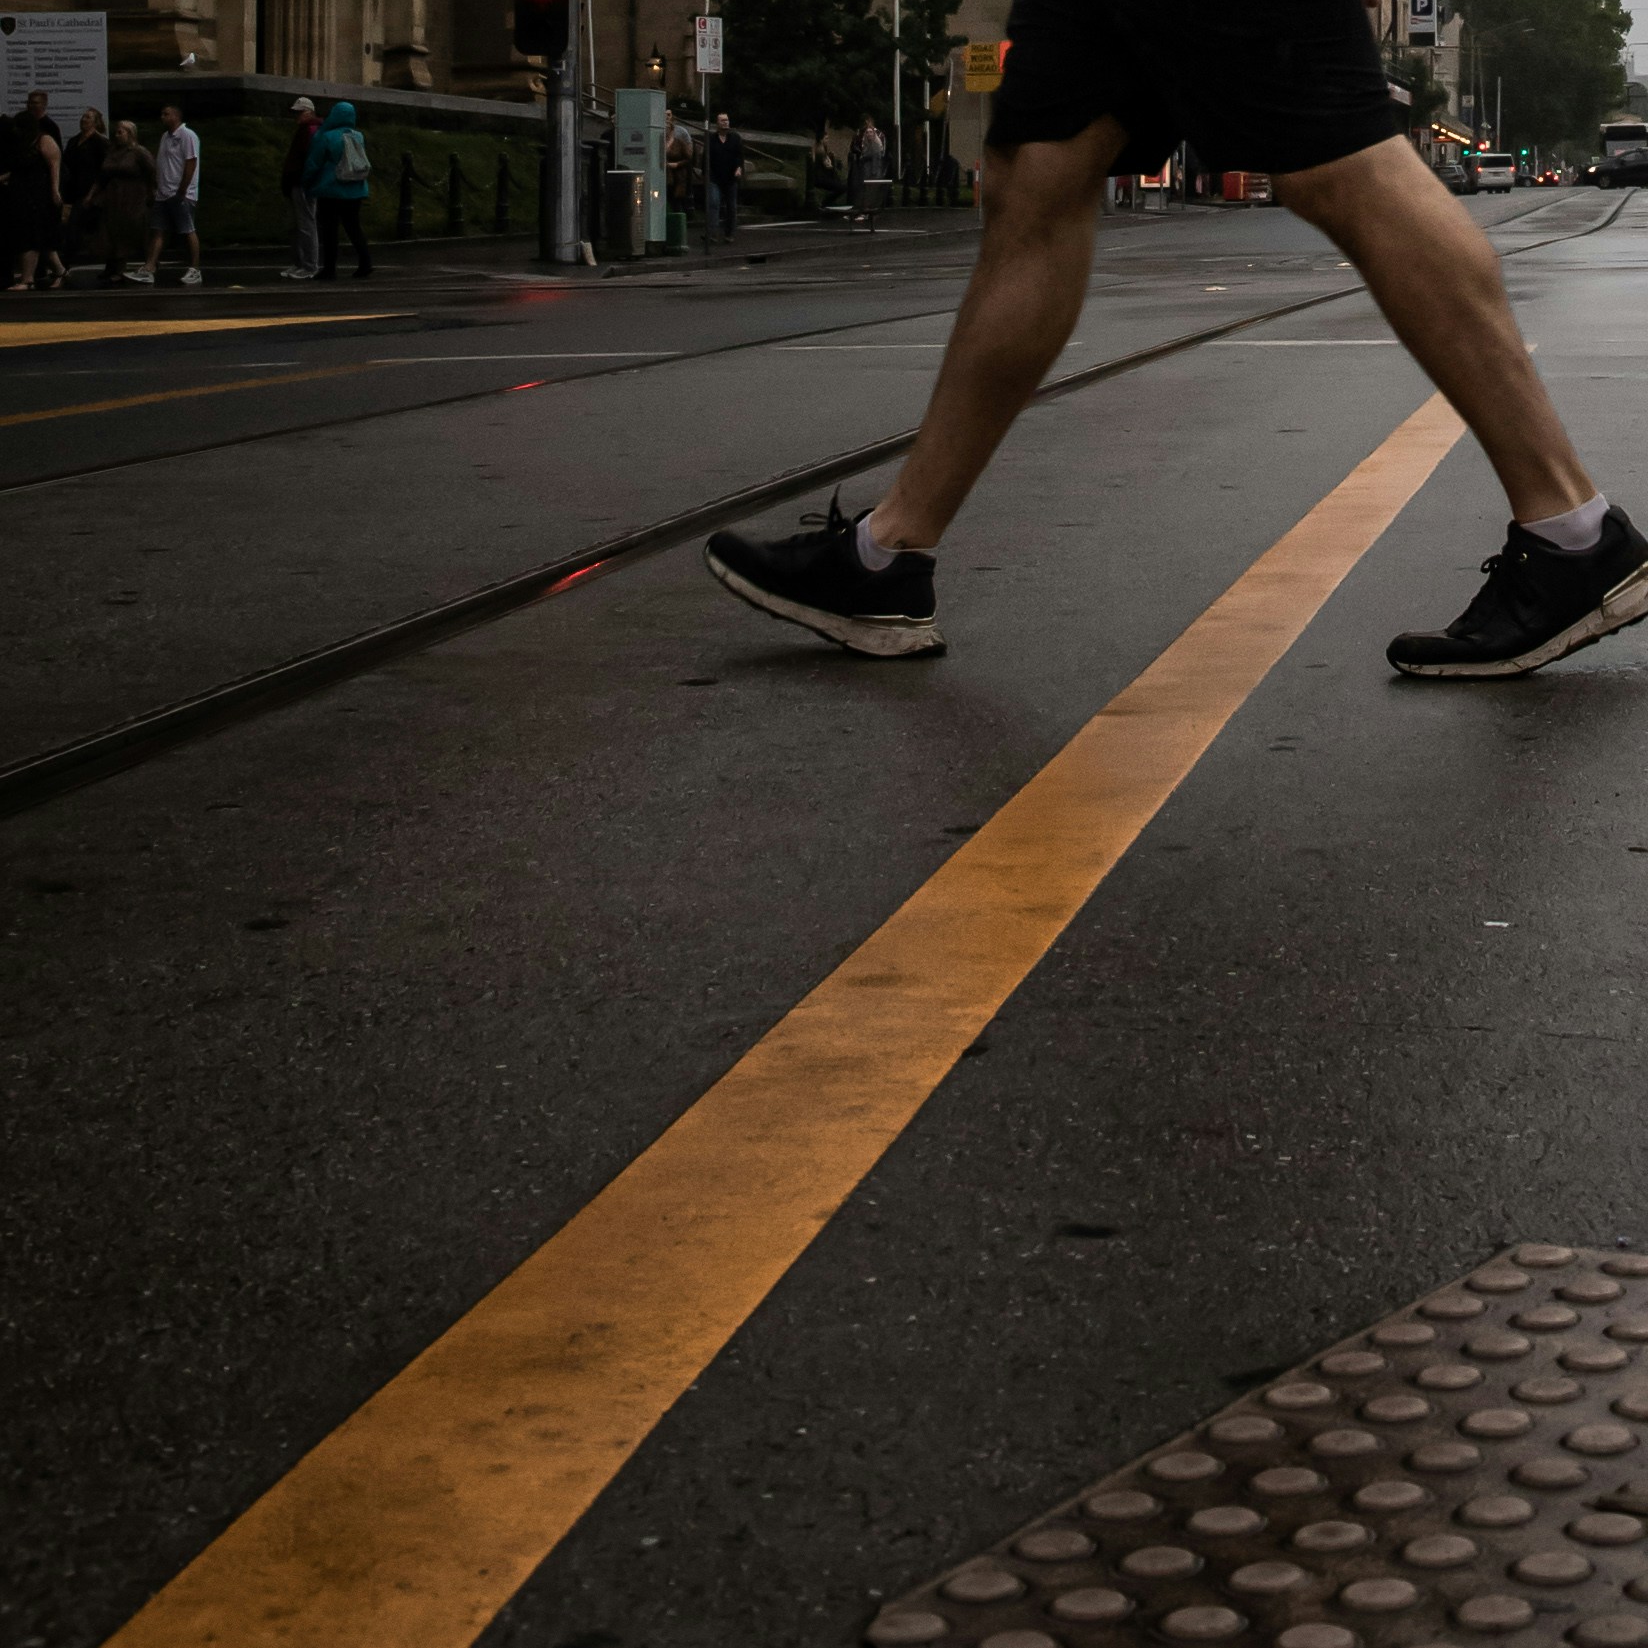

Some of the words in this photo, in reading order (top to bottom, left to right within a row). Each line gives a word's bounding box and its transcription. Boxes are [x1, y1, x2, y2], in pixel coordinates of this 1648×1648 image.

[57, 17, 103, 28] Cathedral
[971, 44, 993, 52] ROAD
[970, 54, 994, 62] WORK
[968, 64, 998, 72] AHEAD
